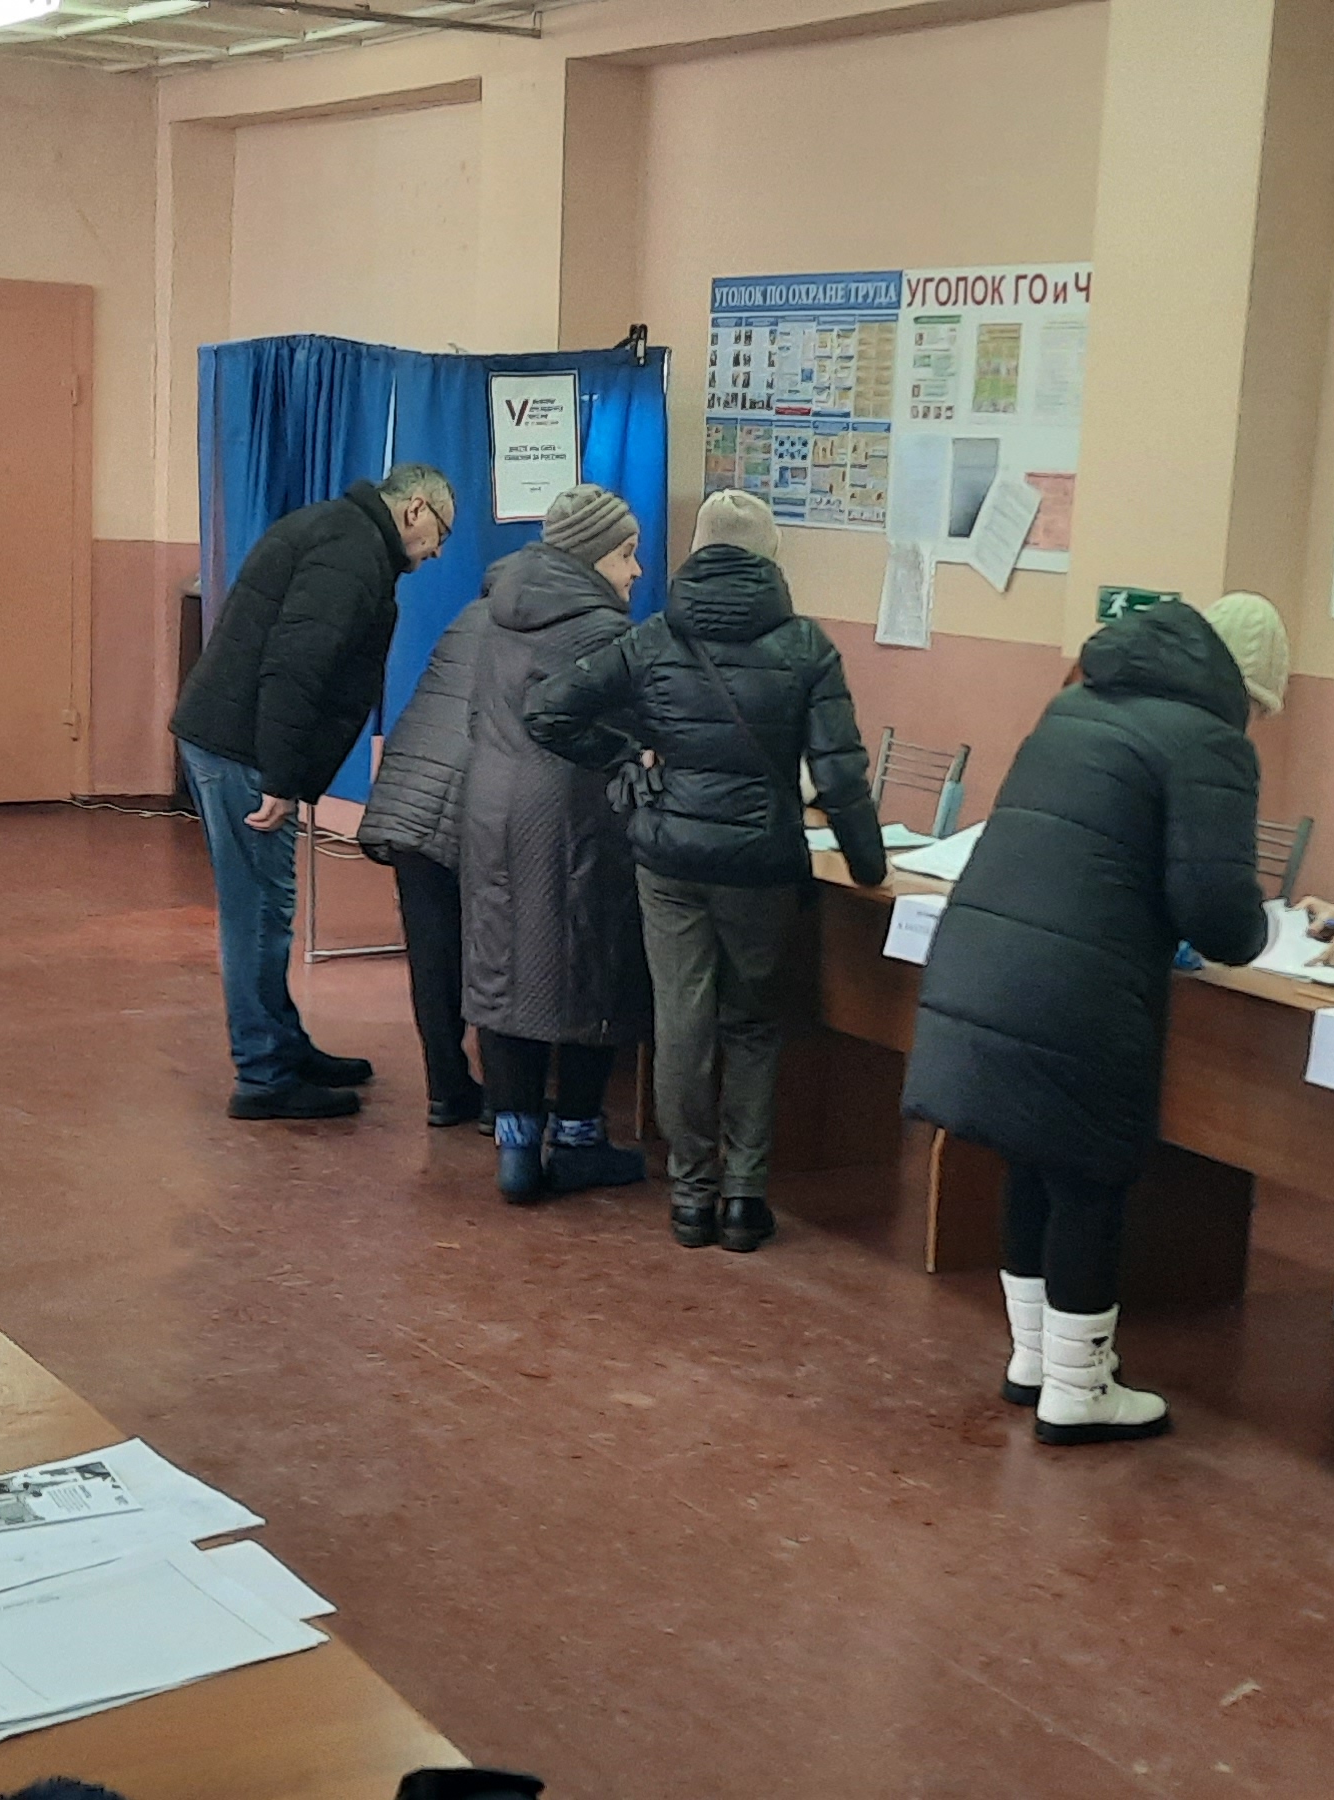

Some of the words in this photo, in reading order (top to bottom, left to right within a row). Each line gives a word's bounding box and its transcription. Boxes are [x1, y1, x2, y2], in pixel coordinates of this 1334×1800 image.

[713, 284, 764, 308] УГОЛОК
[767, 283, 786, 306] ПО
[787, 282, 845, 305] ОХРАНЕ
[847, 280, 898, 304] ТРУДА
[906, 275, 1006, 308] УГОЛОК
[1013, 273, 1048, 305] ГО
[1053, 280, 1069, 304] и
